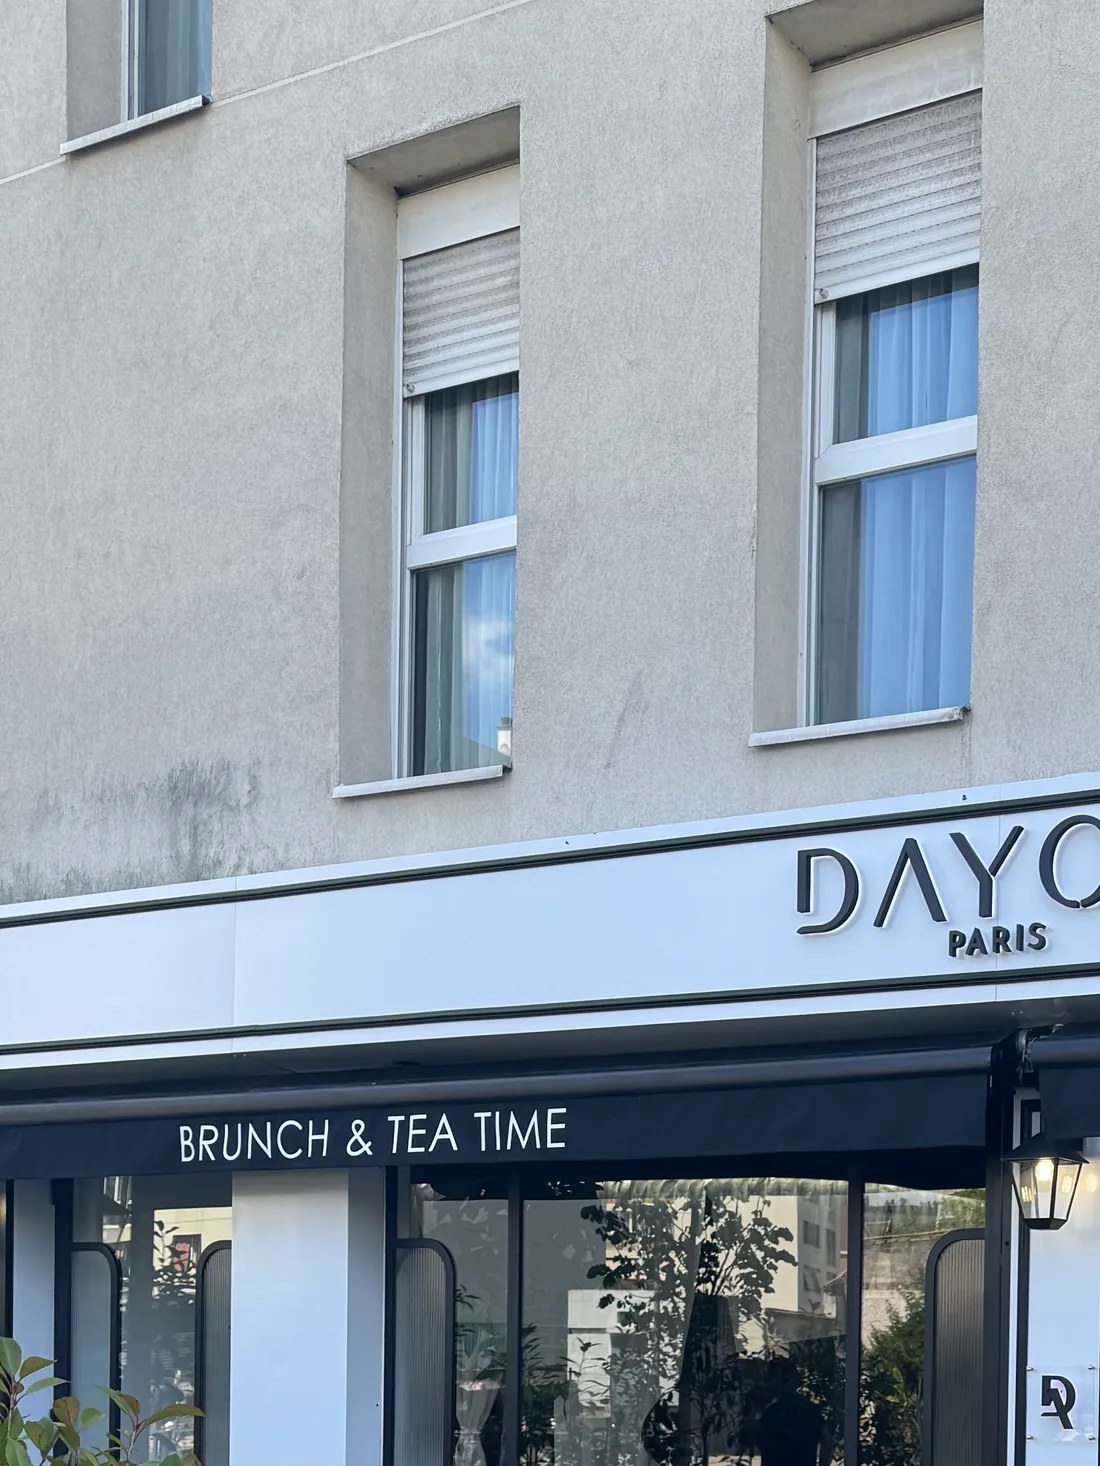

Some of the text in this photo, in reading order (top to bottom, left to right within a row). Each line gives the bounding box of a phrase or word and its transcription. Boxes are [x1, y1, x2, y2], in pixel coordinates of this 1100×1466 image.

[948, 921, 1048, 958] PARIS
[178, 1107, 568, 1164] BRUNCH & TEA TIME
